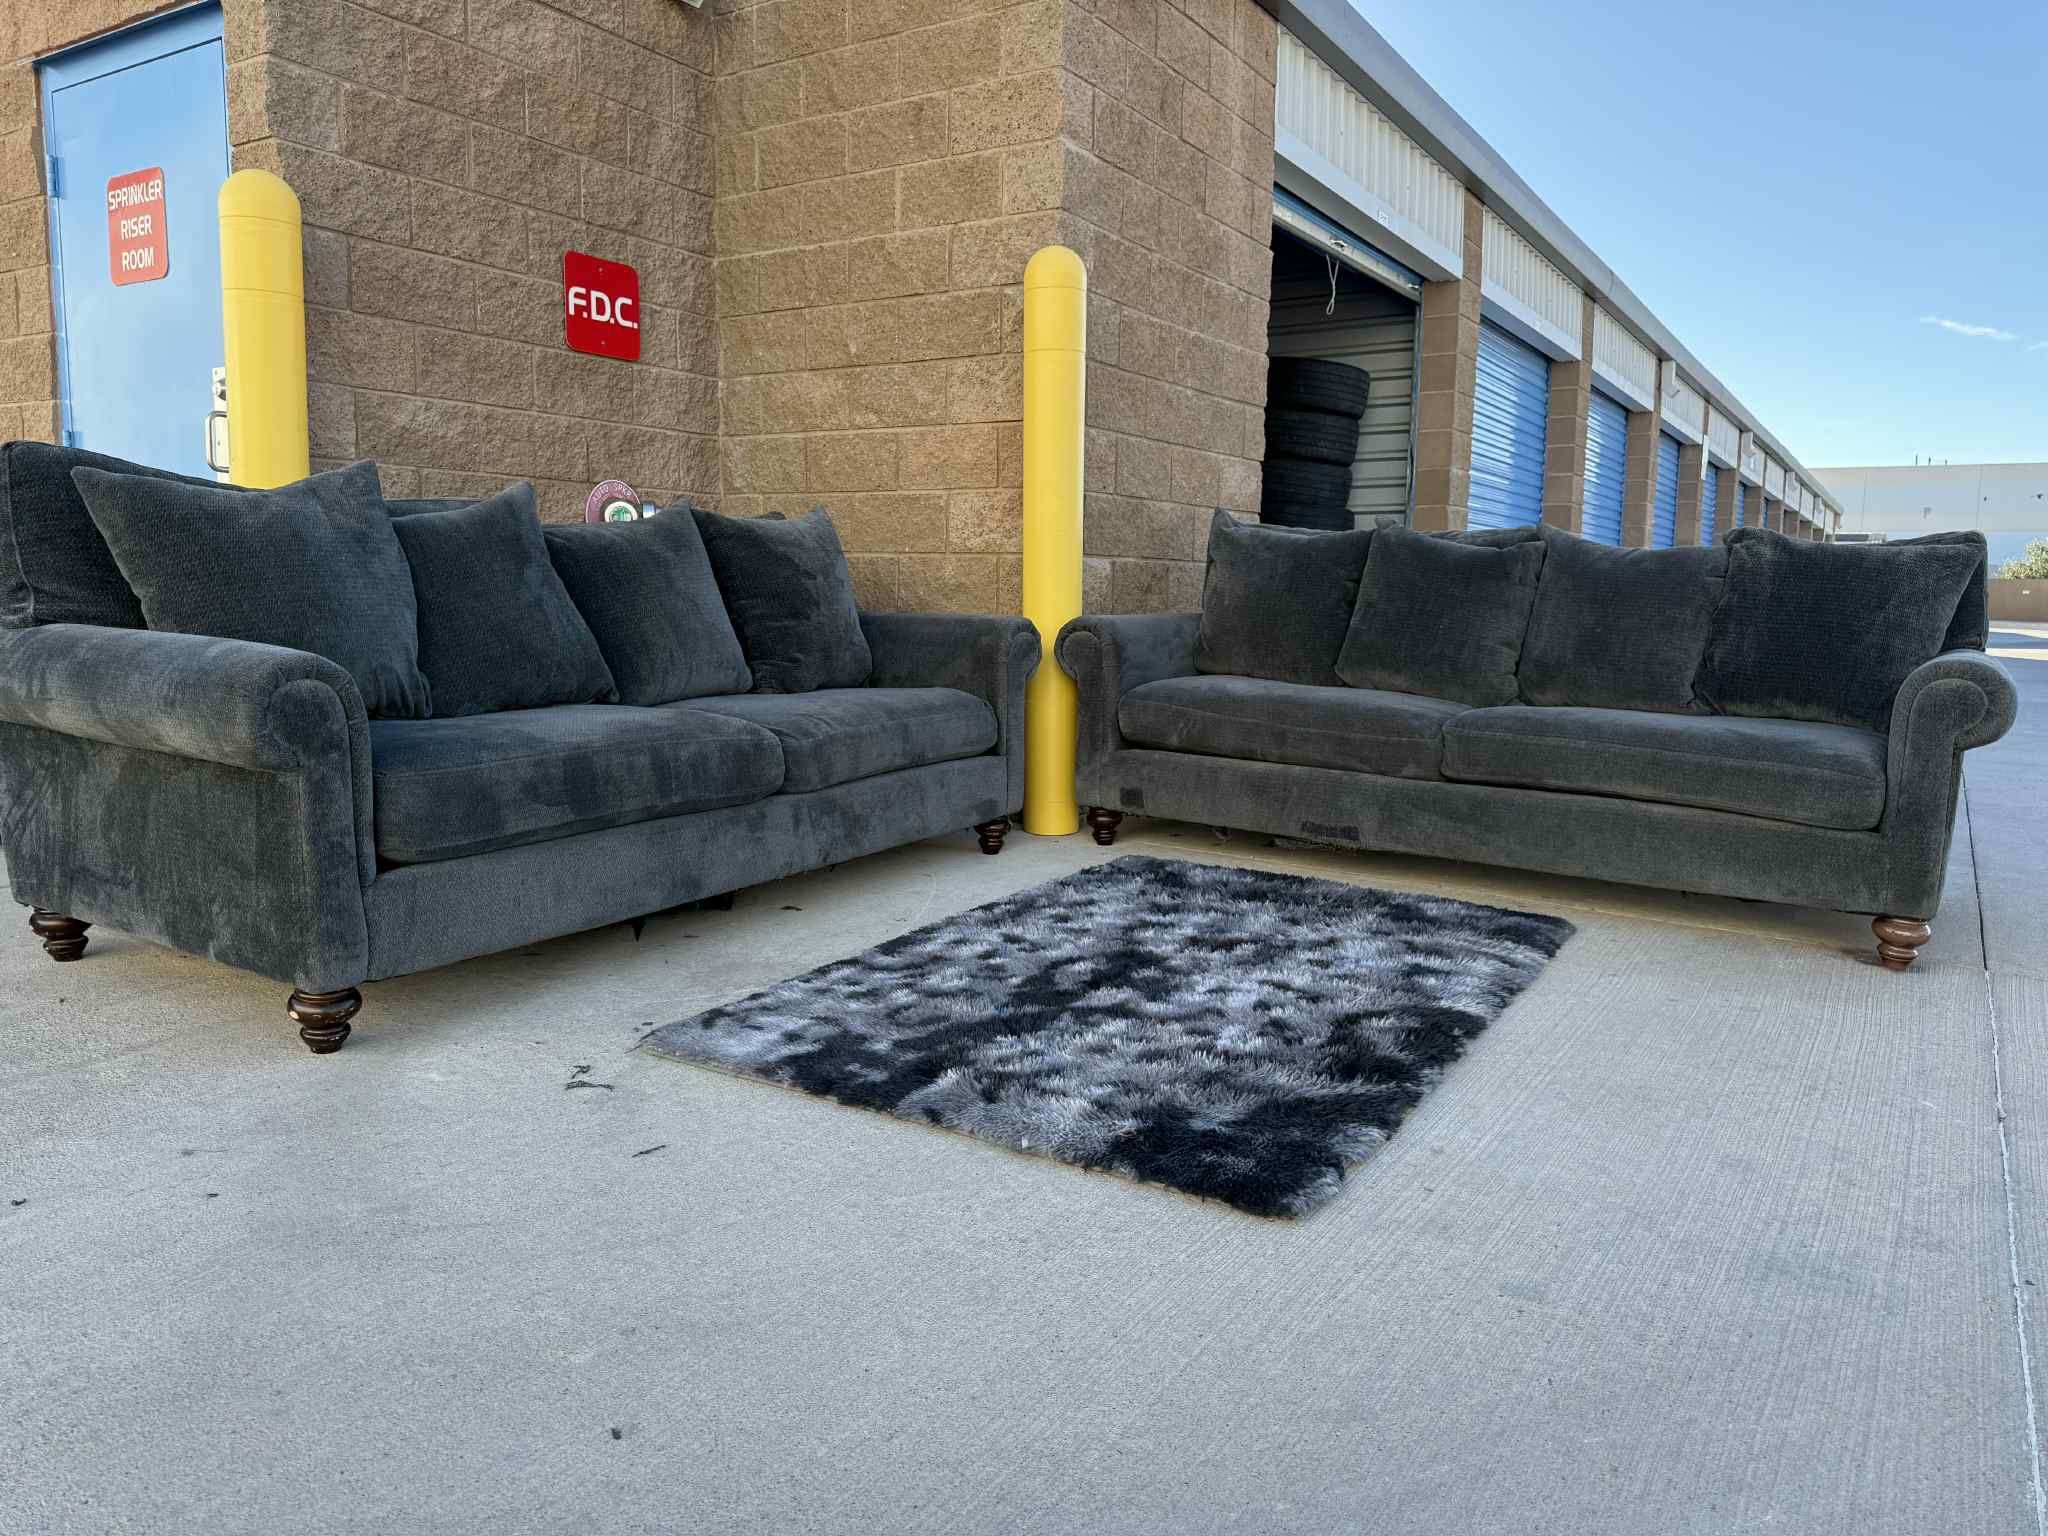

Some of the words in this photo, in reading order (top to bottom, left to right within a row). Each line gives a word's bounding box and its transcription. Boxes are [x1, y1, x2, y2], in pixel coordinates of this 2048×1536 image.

[108, 179, 162, 210] SPRINKLER
[120, 214, 152, 240] RISER
[122, 246, 154, 271] ROOM
[568, 286, 638, 329] F.D.C.
